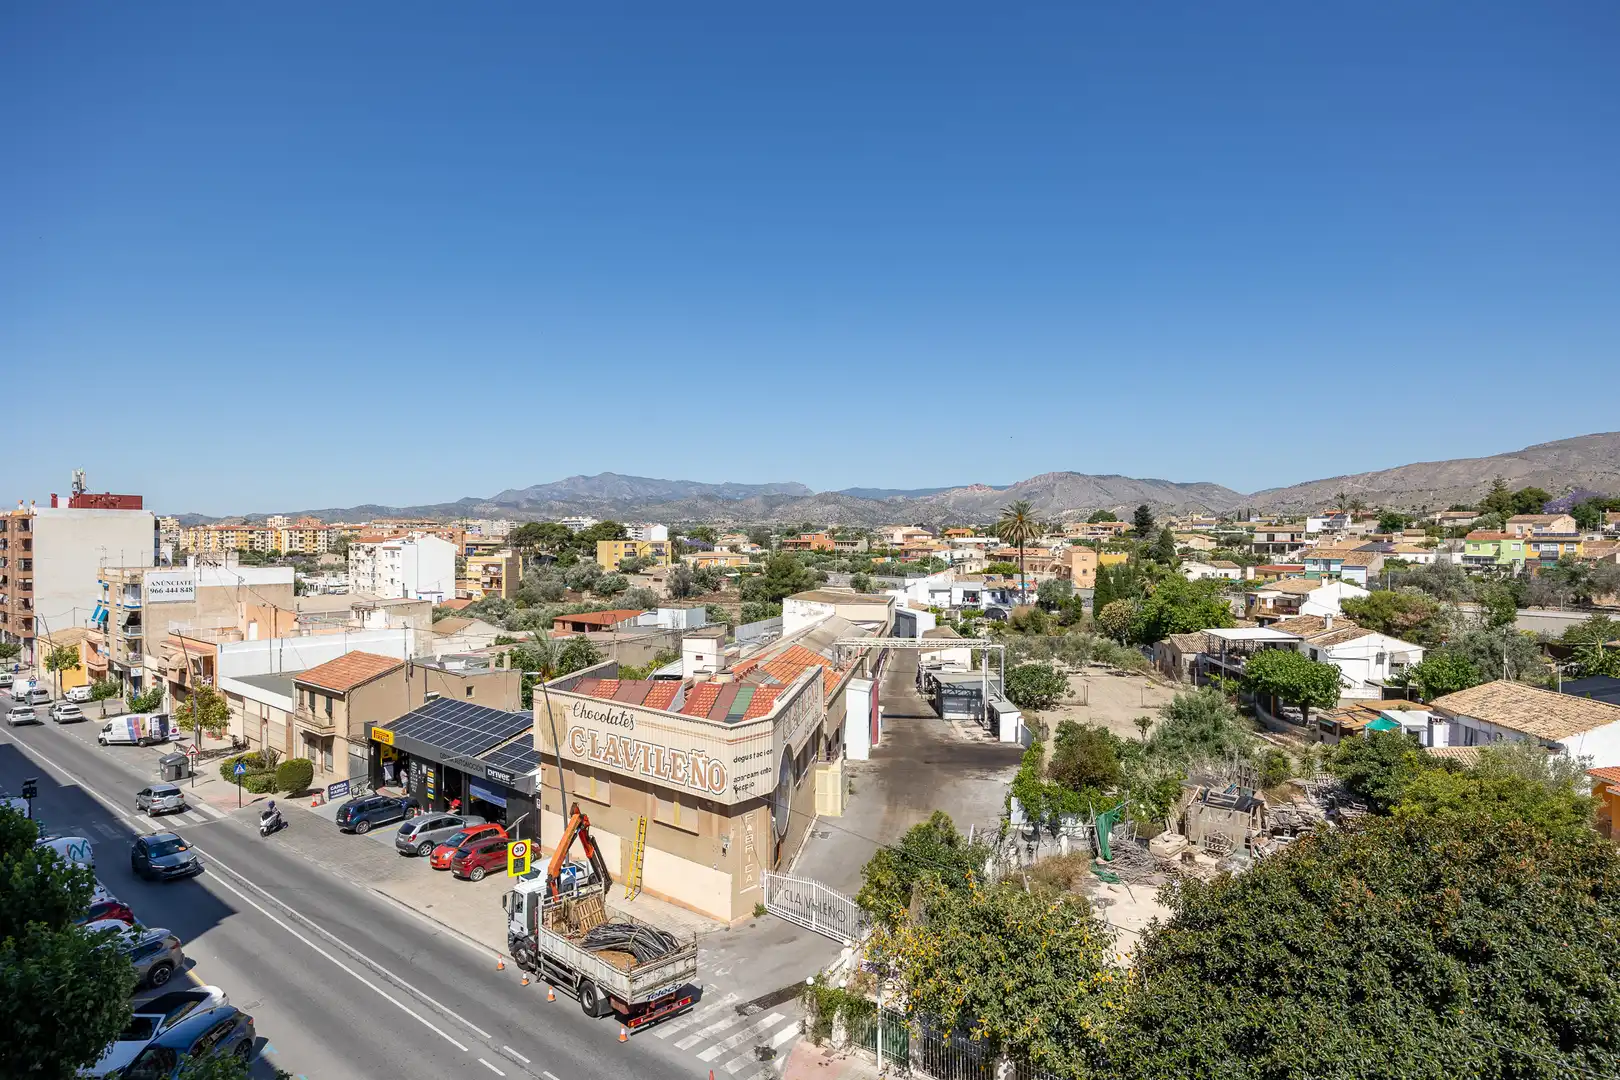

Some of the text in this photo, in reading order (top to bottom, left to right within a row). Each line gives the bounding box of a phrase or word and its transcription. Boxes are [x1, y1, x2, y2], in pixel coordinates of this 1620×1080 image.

[572, 701, 635, 731] Chocolates
[569, 725, 729, 795] CLAVILEÑO
[330, 782, 347, 791] CARGA
